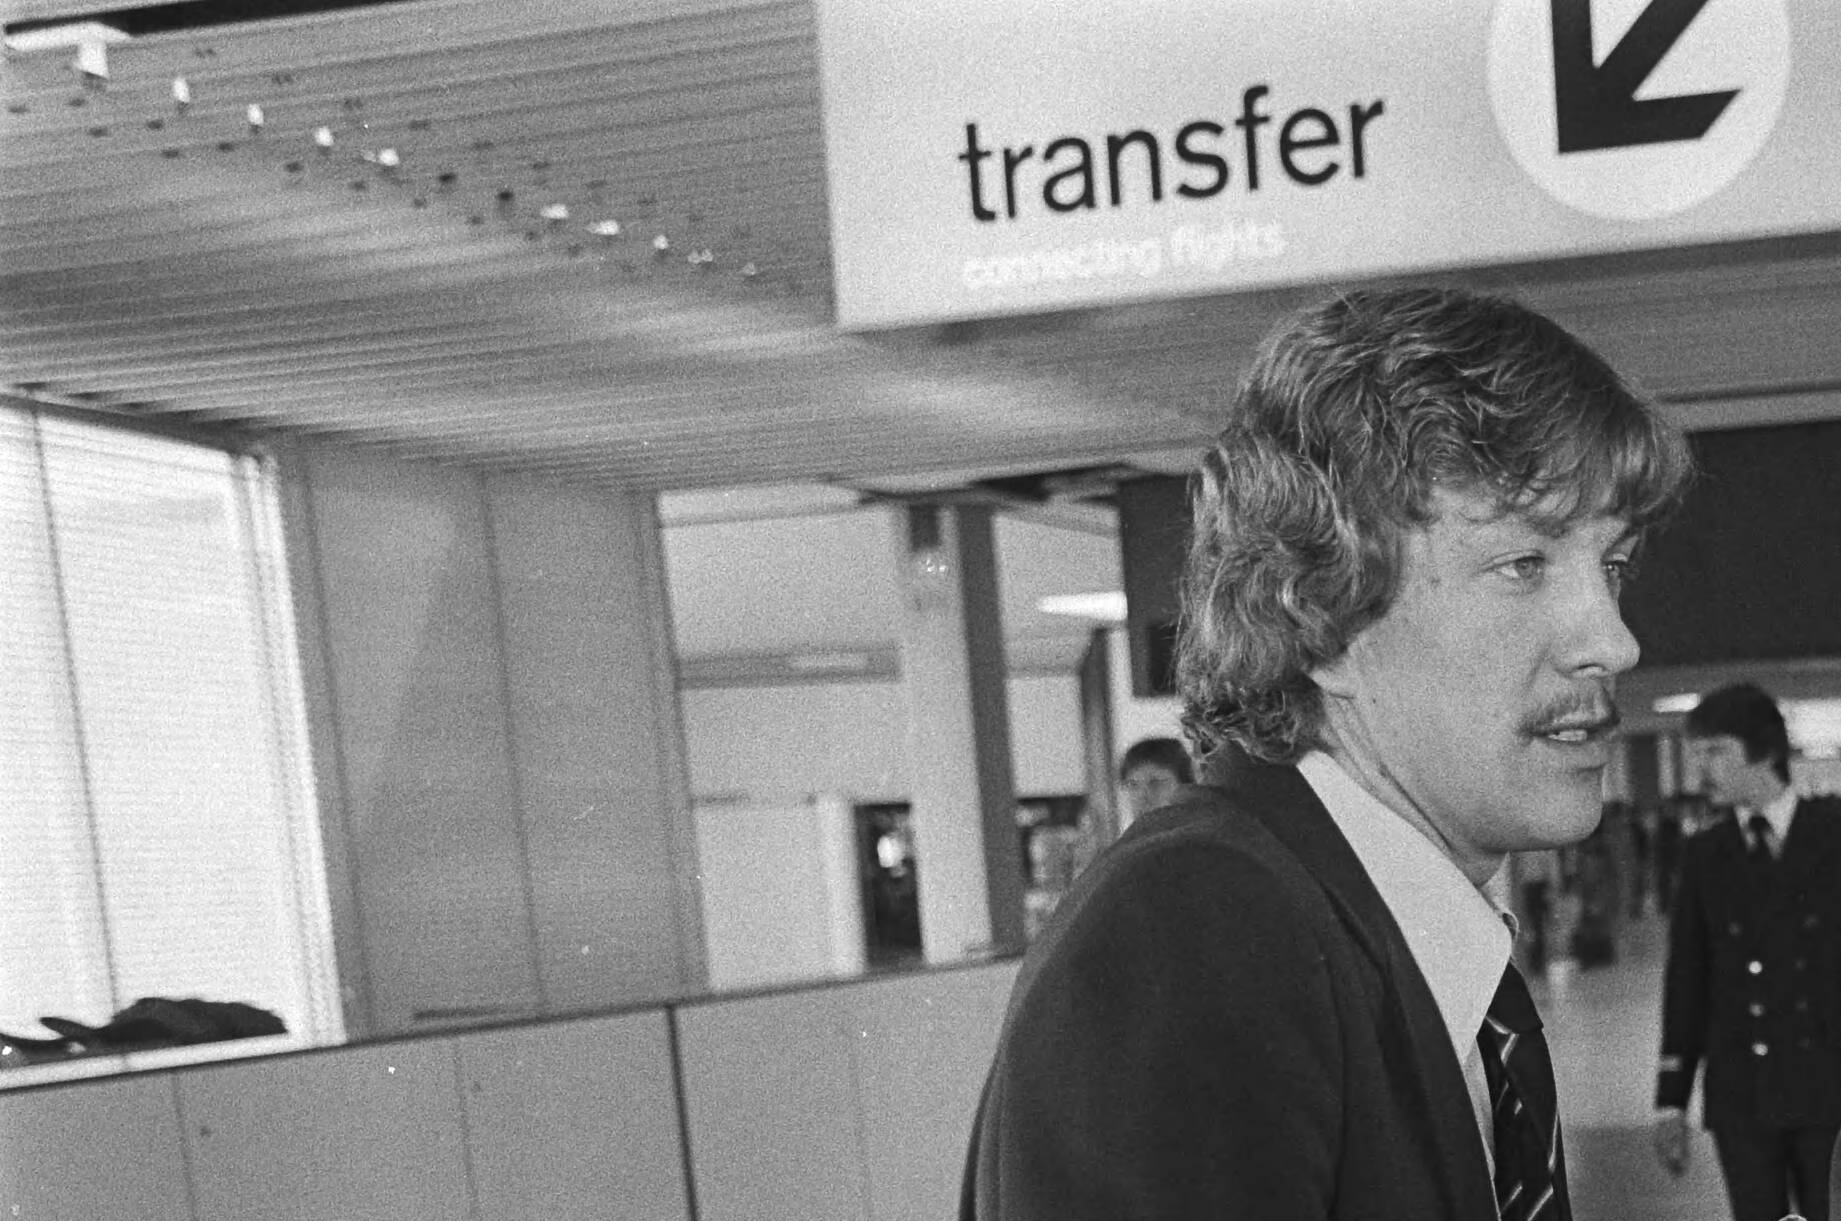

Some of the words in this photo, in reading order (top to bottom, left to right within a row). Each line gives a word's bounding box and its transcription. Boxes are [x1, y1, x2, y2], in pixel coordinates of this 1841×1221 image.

[958, 84, 1384, 221] transfer
[960, 238, 1161, 287] connecting
[1169, 221, 1287, 271] flights
